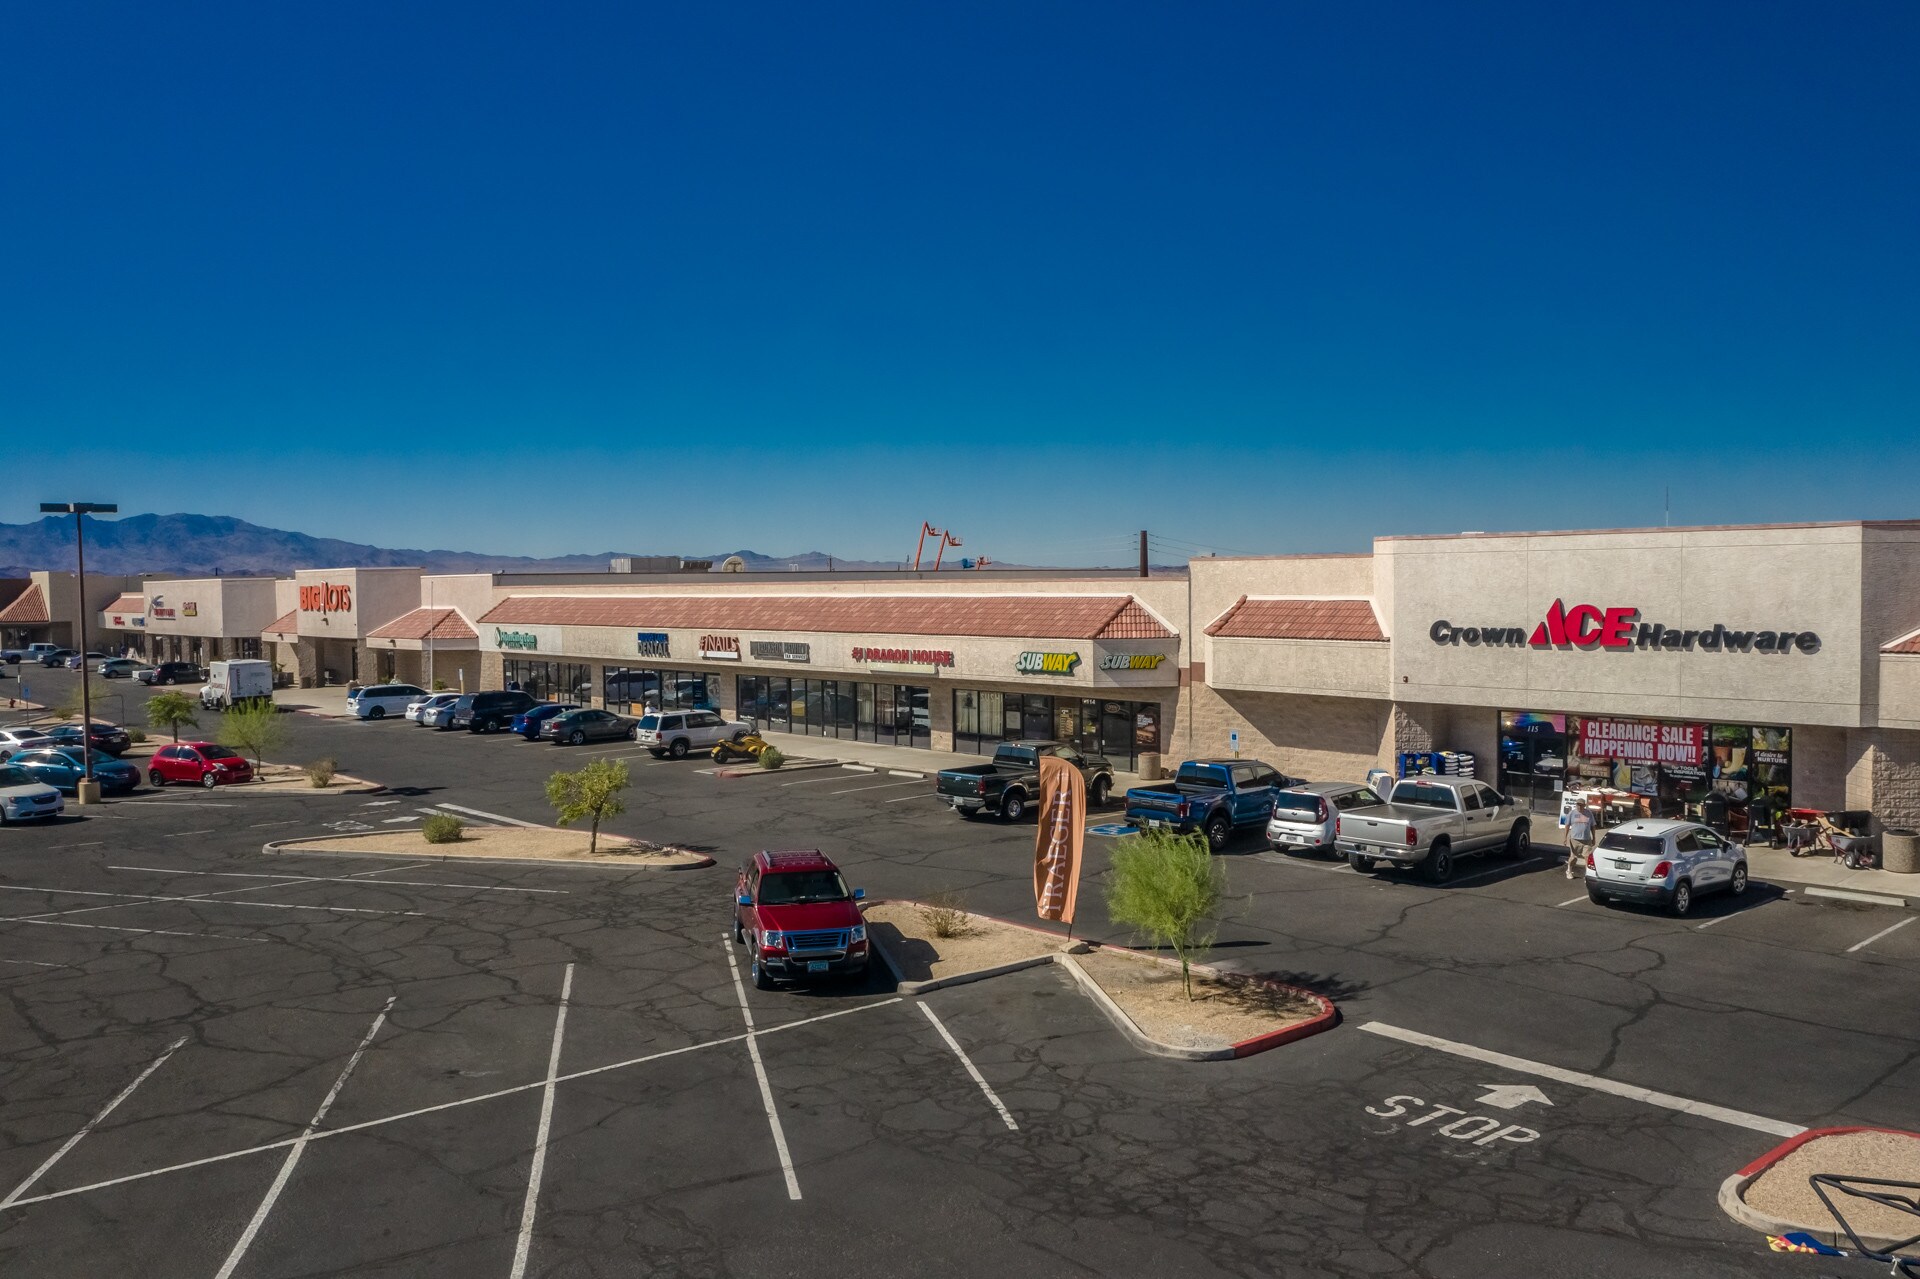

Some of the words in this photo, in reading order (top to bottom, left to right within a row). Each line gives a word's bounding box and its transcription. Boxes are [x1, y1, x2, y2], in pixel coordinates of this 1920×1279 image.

[1430, 619, 1526, 647] Crown
[1528, 598, 1637, 648] ACE
[1636, 624, 1821, 654] Hardware
[708, 635, 738, 652] NAILS
[866, 648, 910, 661] DRAGON
[912, 650, 952, 664] HOUSE
[1017, 652, 1077, 672] SUBWAY
[1100, 654, 1165, 670] SUBWAY
[1528, 725, 1539, 733] 115
[1587, 721, 1658, 743] CLEARANCE
[1661, 726, 1694, 745] SALE
[1584, 738, 1654, 760] HAPPENING
[1657, 743, 1697, 763] NOW!!
[1365, 1095, 1541, 1146] STOP
